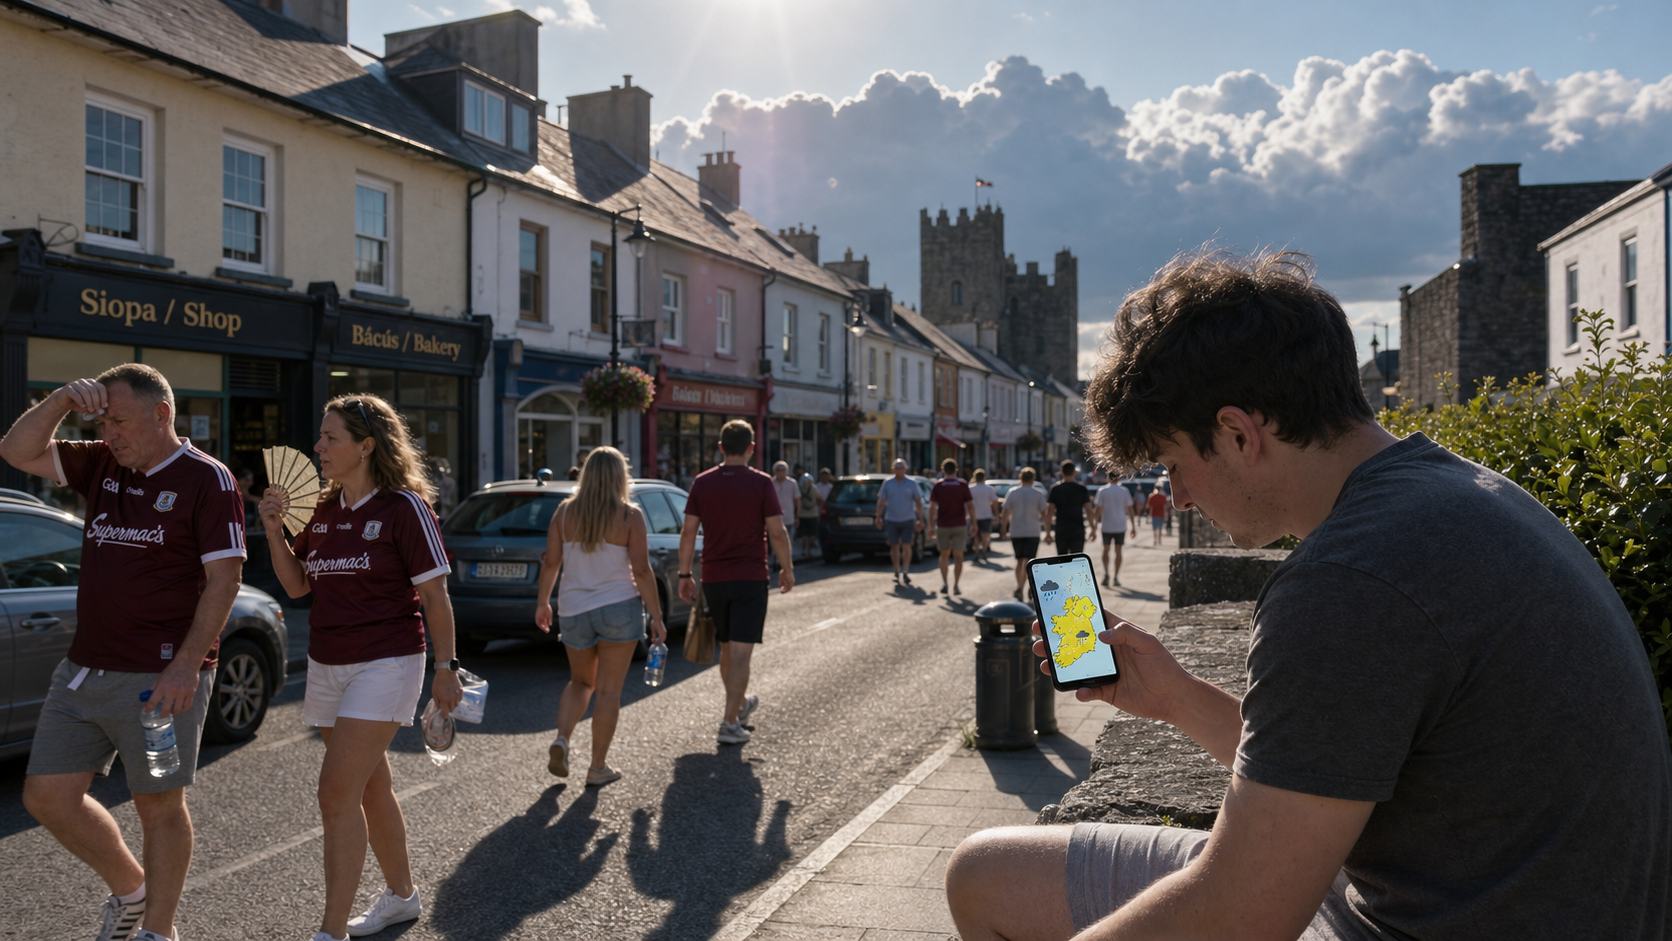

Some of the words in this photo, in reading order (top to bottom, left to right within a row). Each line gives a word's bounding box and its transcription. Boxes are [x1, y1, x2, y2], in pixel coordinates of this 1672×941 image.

[80, 288, 157, 327] Siopa
[163, 298, 176, 325] /
[183, 302, 242, 338] Shop
[351, 324, 399, 350] Bácús
[402, 331, 411, 353] /
[413, 333, 462, 362] Bakery
[86, 513, 165, 547] Supermac's
